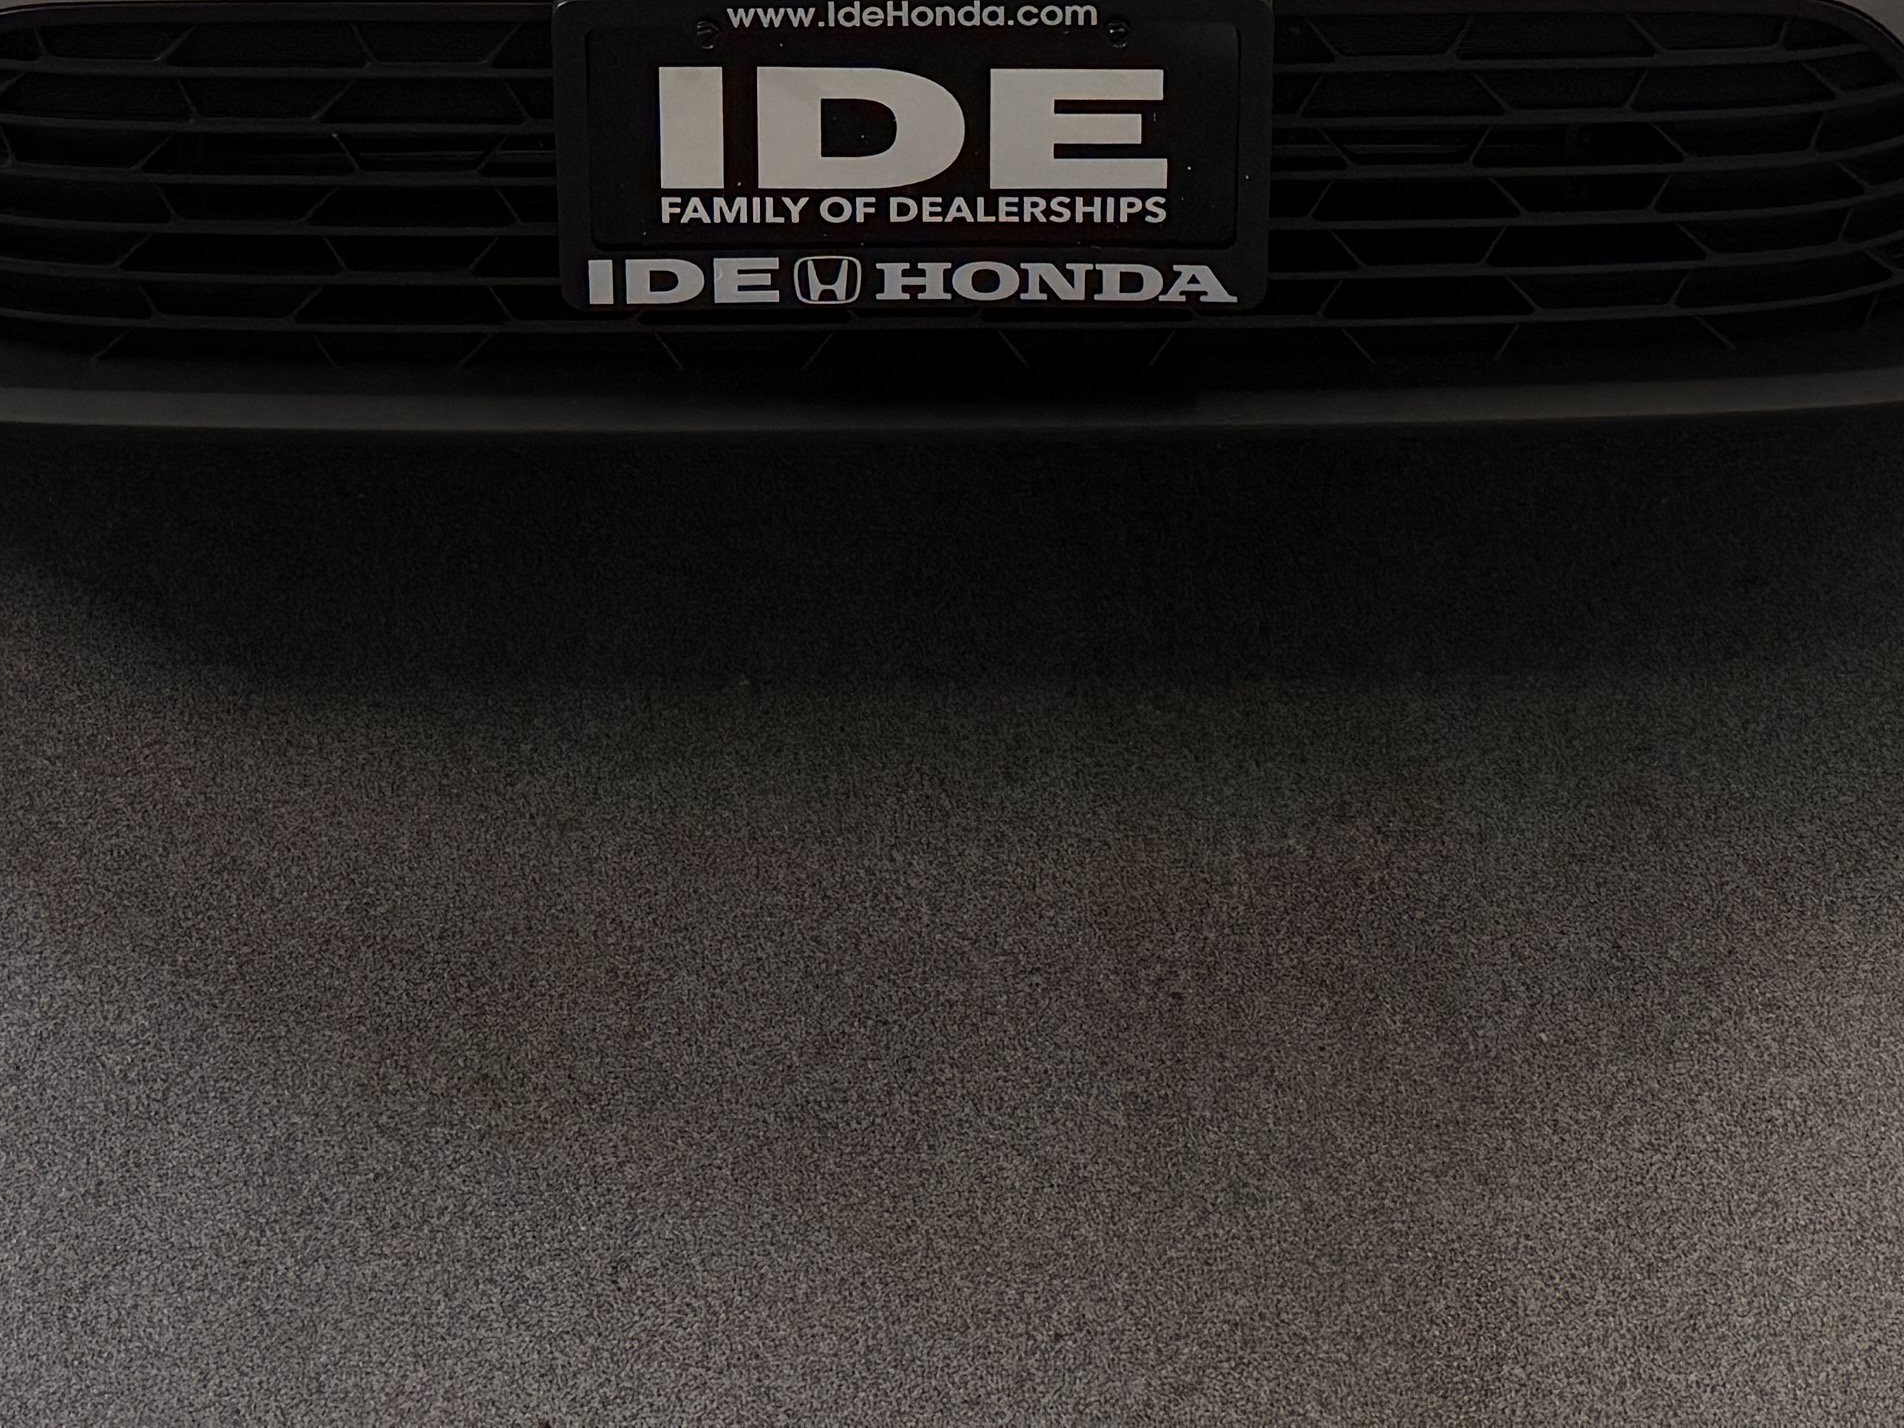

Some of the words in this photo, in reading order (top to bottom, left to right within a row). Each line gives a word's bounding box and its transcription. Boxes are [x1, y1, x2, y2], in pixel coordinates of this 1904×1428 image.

[657, 65, 1169, 191] IDE
[660, 195, 810, 225] FAMILY
[819, 195, 877, 225] OF
[888, 195, 1168, 225] DEALERSHIPS
[587, 255, 781, 306] IDE
[875, 260, 1238, 304] HONDA
